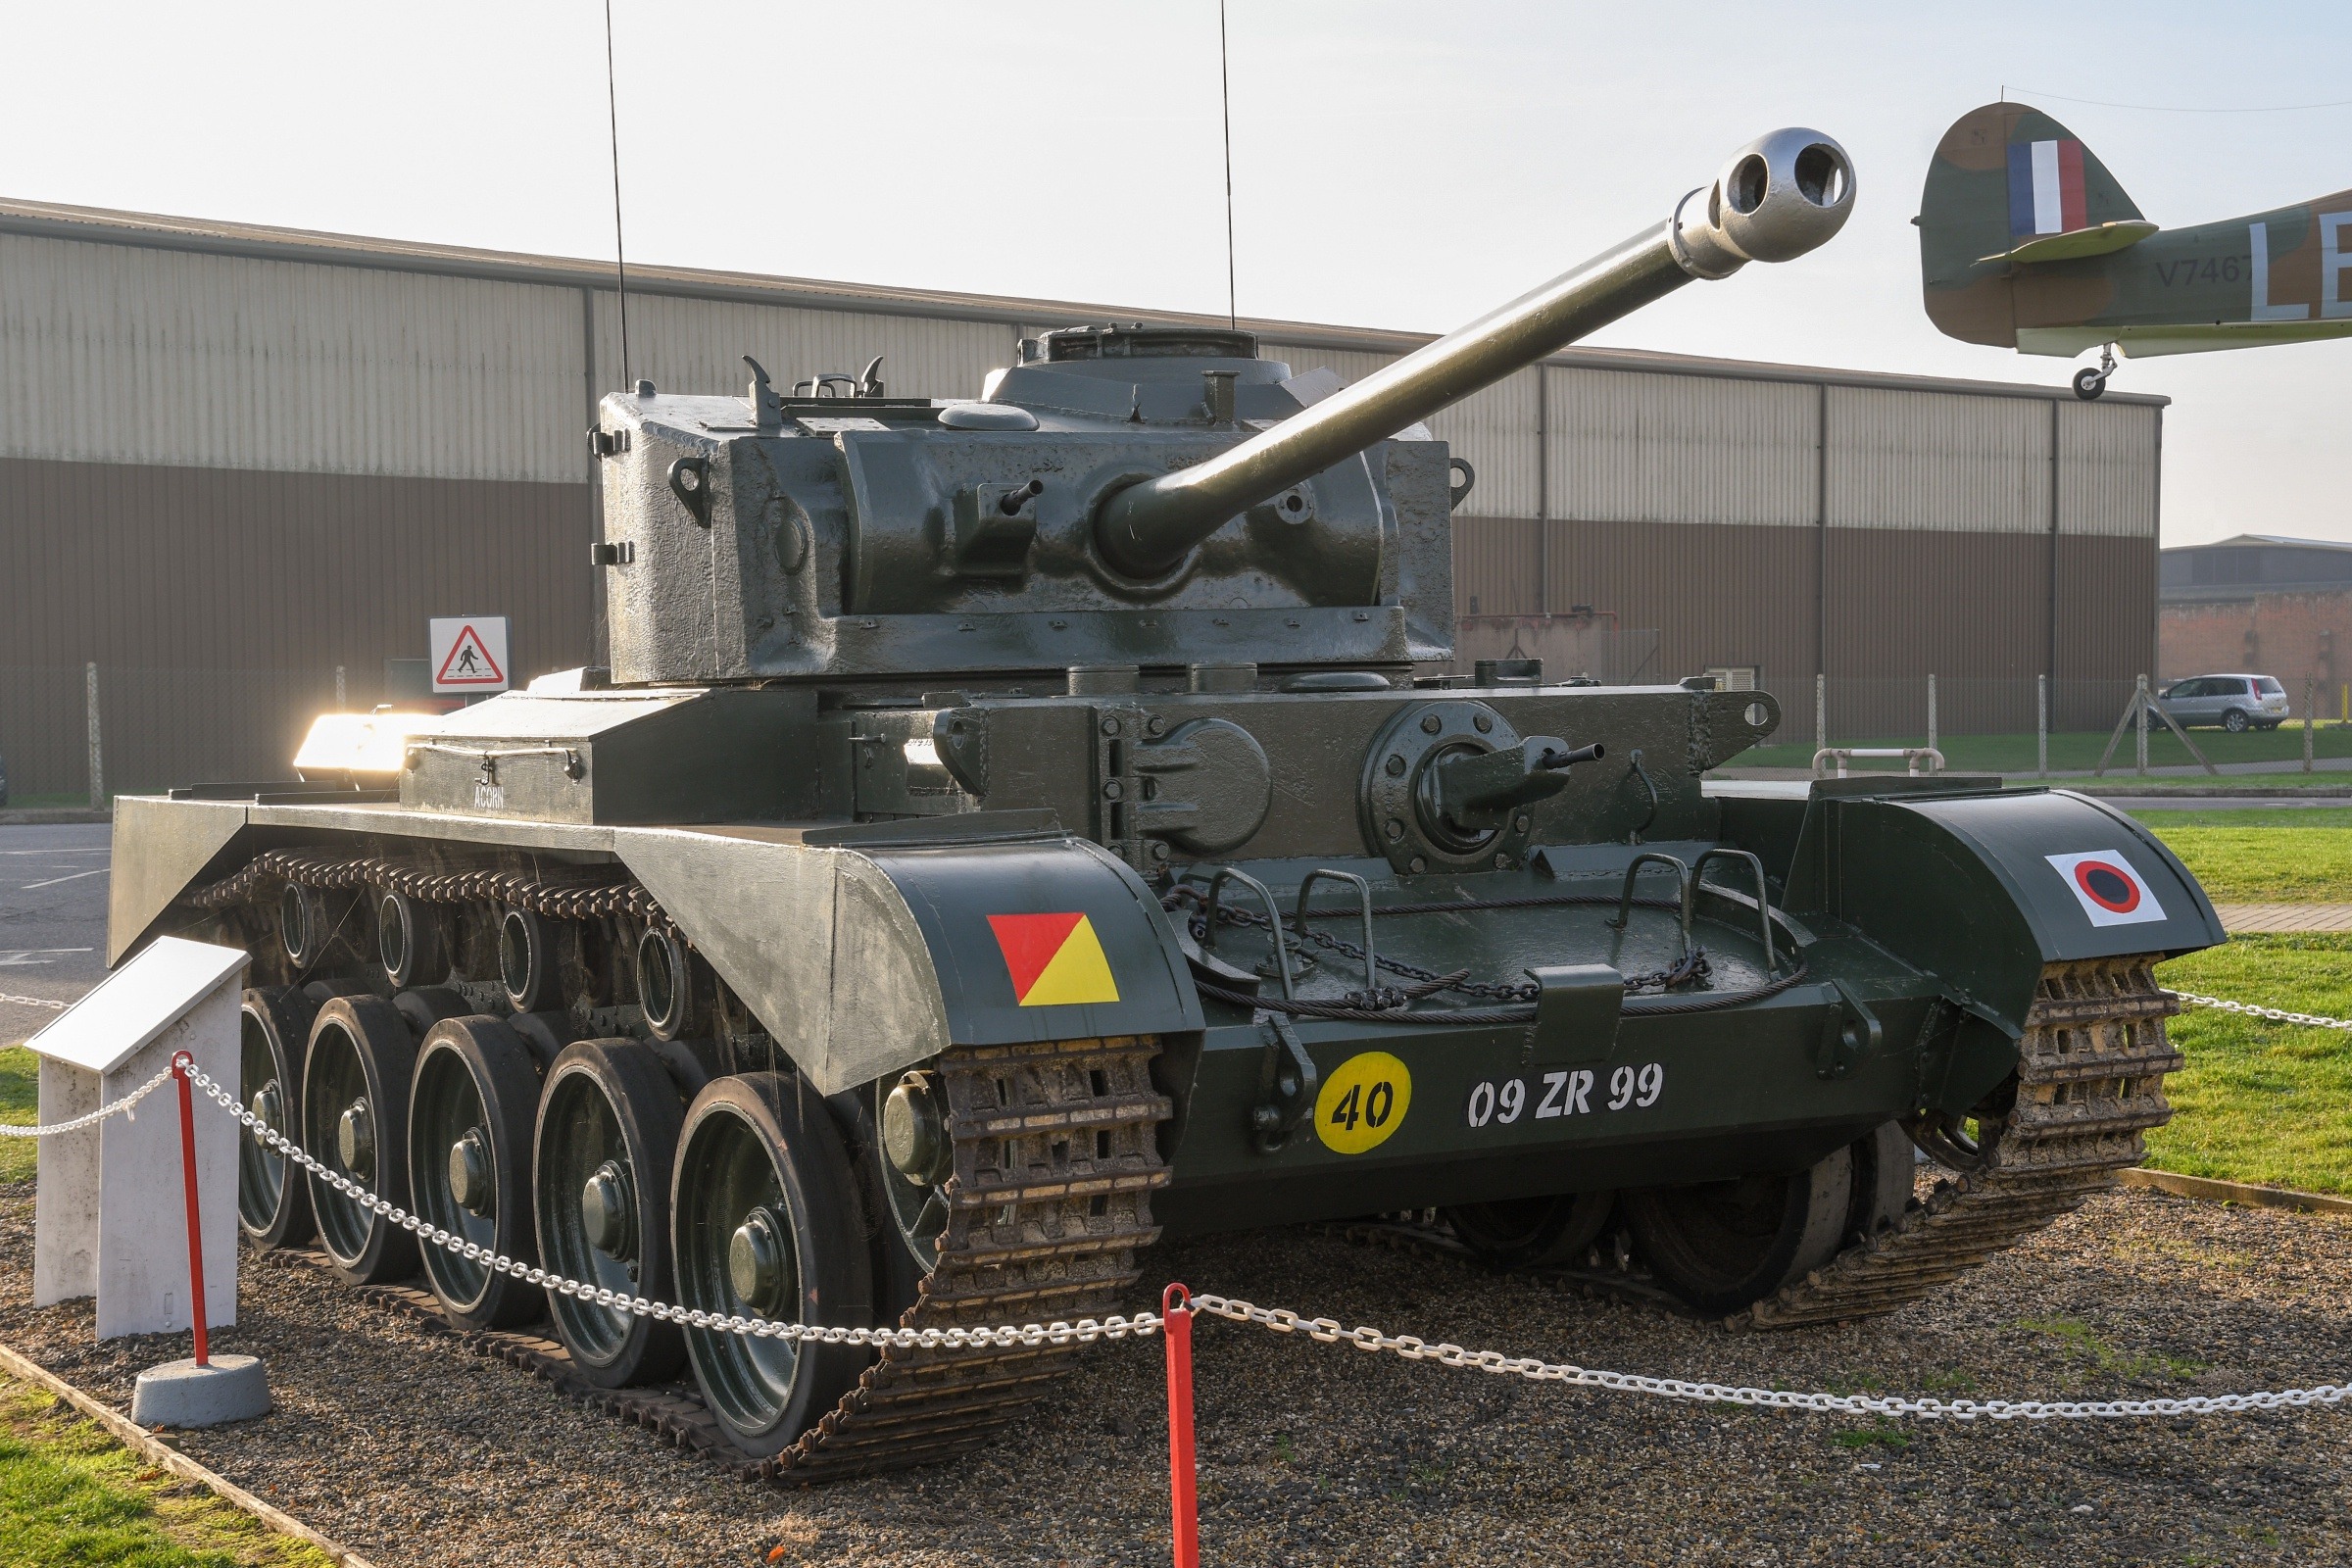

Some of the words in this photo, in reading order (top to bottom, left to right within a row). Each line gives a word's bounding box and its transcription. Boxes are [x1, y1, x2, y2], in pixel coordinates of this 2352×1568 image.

[474, 786, 504, 808] ACORN
[1331, 1081, 1394, 1131] 40
[1468, 1078, 1526, 1127] 09
[1535, 1069, 1594, 1119] ZR
[1607, 1062, 1663, 1110] 99
